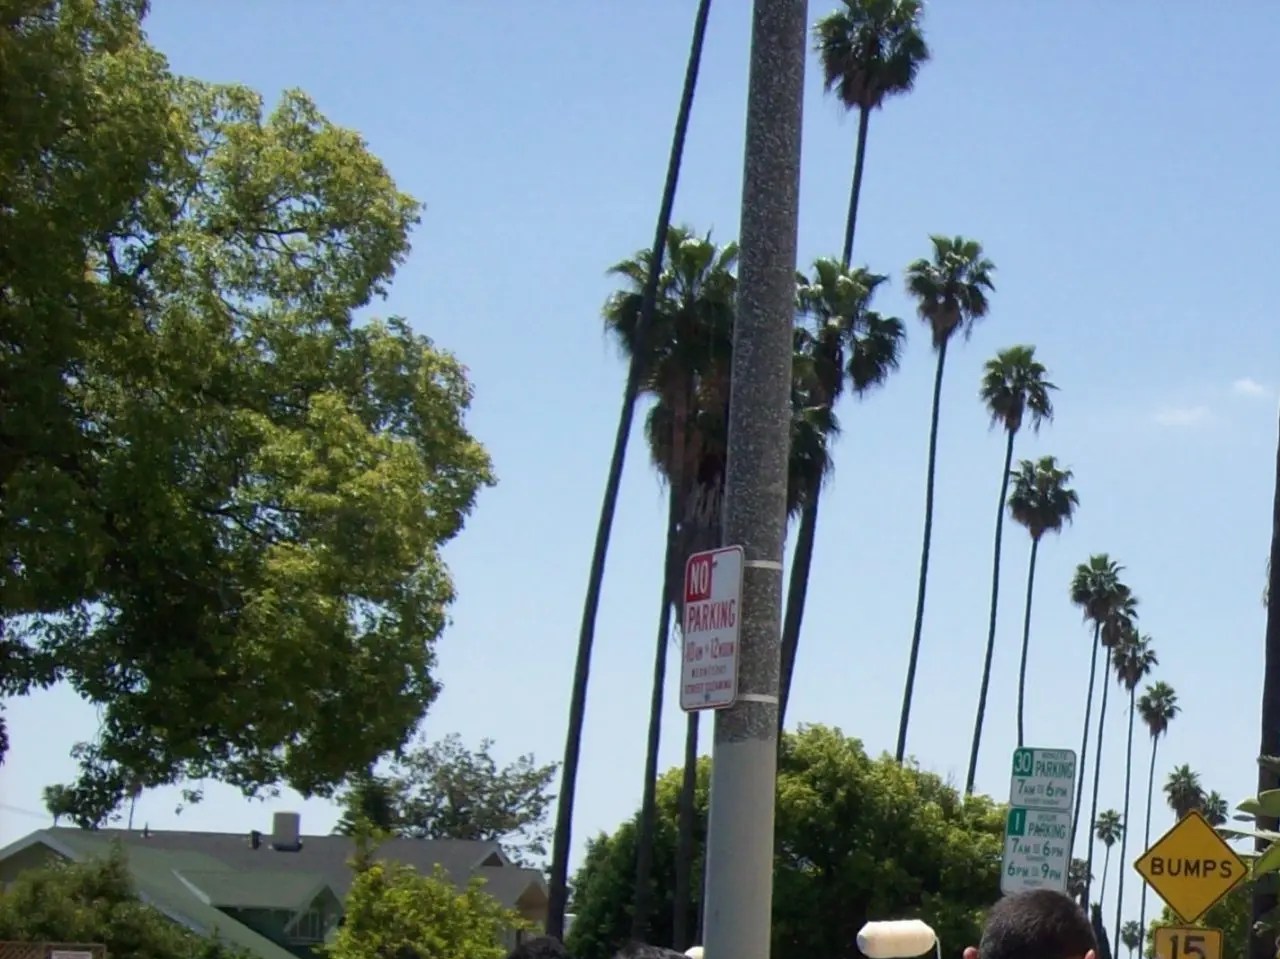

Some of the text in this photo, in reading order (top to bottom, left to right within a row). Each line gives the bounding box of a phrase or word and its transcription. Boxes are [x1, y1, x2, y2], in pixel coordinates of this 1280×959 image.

[690, 560, 709, 595] NO
[687, 600, 736, 633] PARKING
[1014, 751, 1032, 772] 30
[1035, 761, 1073, 779] PARKING
[1028, 822, 1066, 840] PARKING
[1150, 857, 1232, 879] BUMPS
